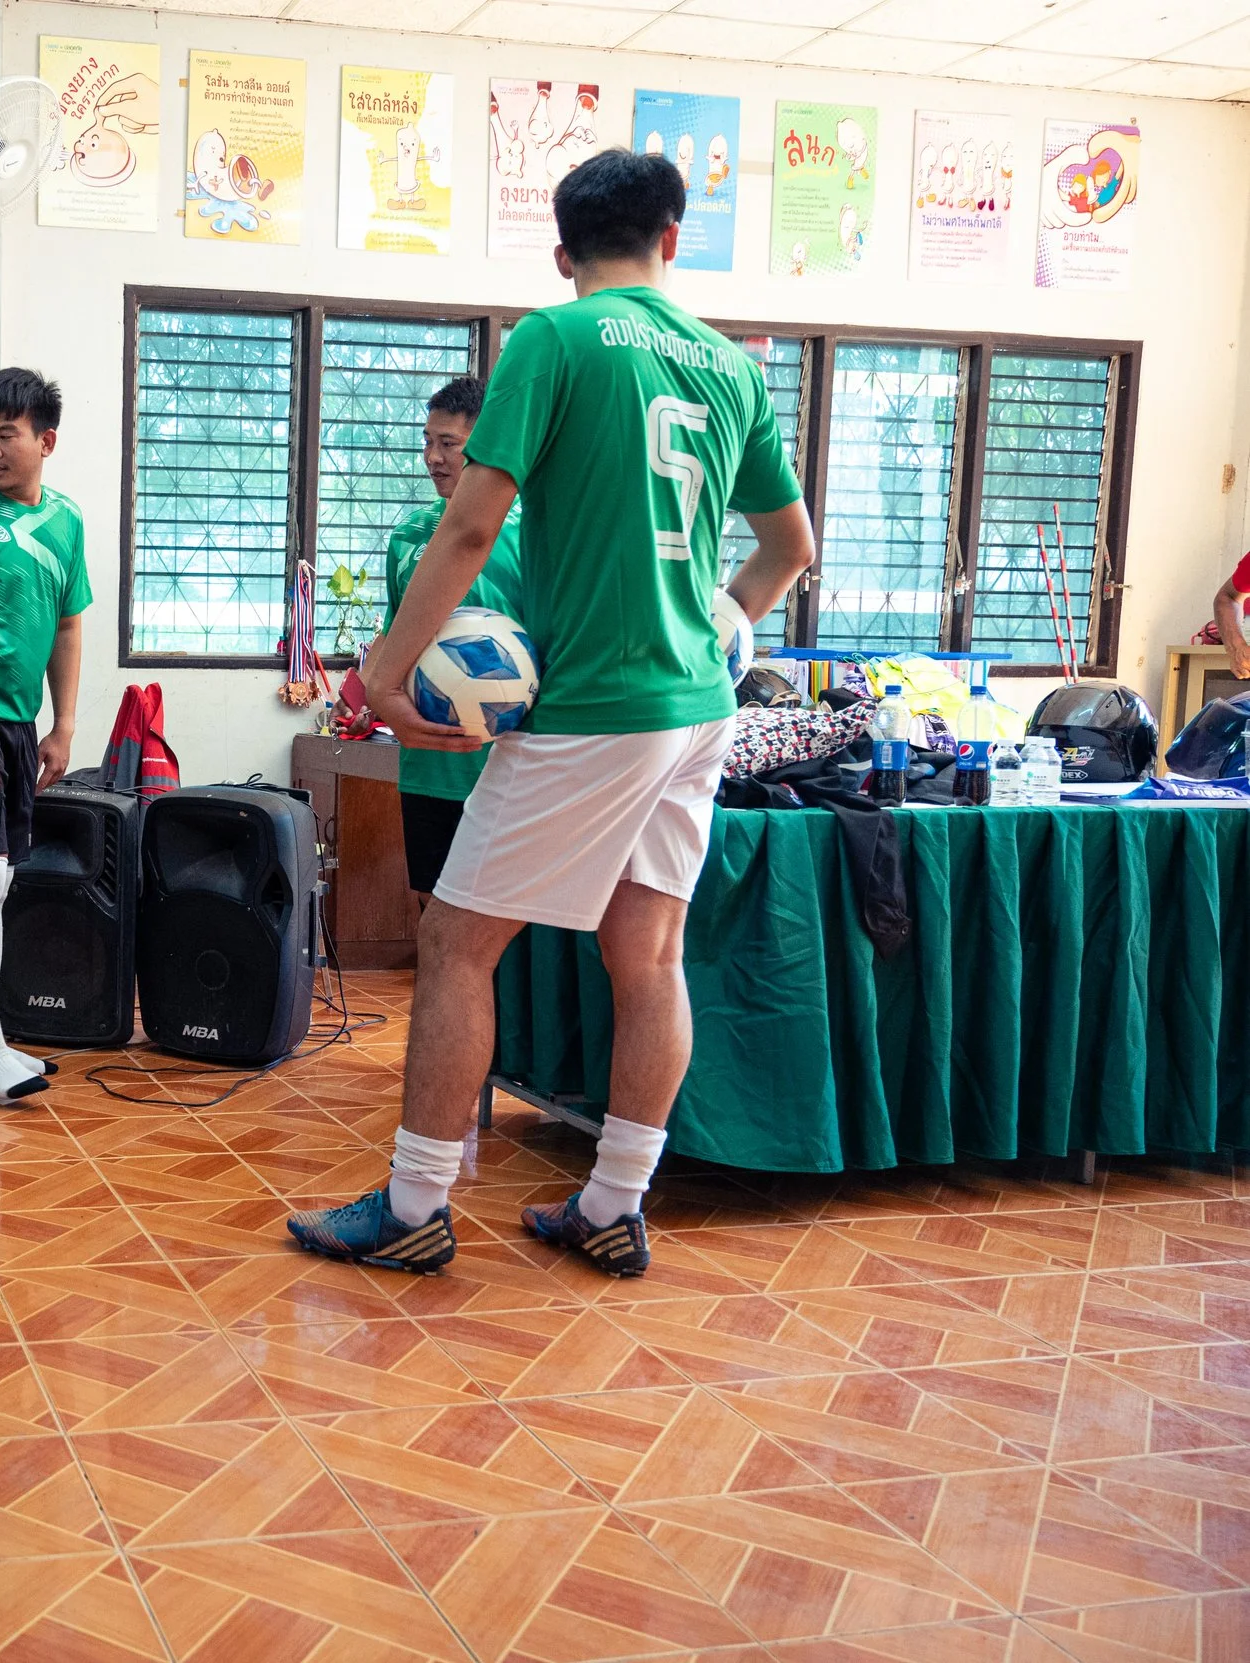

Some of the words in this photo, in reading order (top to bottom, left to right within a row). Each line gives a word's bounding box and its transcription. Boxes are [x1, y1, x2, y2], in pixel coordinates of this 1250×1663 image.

[70, 63, 120, 120] ใครว่ายาก
[204, 72, 230, 88] โลชั่น
[266, 80, 290, 94] ออยล์
[348, 91, 418, 115] ใส่ใกล้หลั่ง
[783, 129, 835, 167] สนุก
[500, 187, 549, 208] ถุงยาง
[648, 394, 710, 562] 5
[28, 995, 67, 1009] MBA
[181, 1024, 219, 1041] MBA
